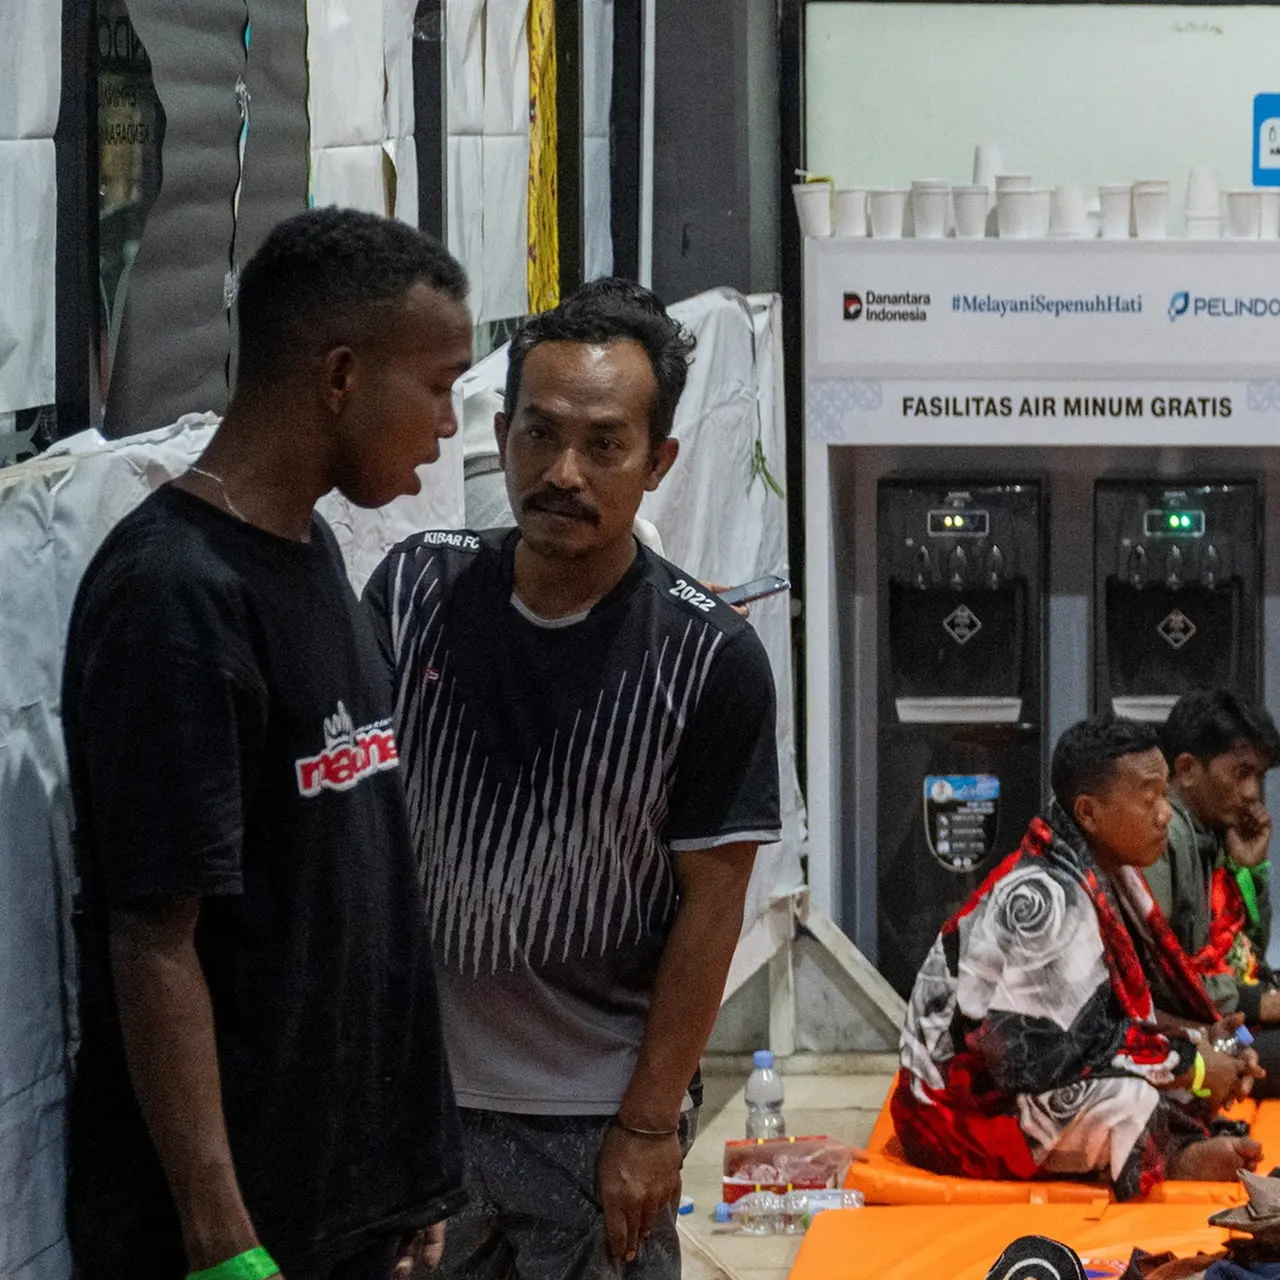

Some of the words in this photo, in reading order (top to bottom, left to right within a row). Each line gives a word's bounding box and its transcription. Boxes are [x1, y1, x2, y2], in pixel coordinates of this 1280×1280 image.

[866, 291, 931, 306] Danantara
[952, 294, 1143, 317] #MelayaniSepenuhHati
[866, 307, 927, 322] Indonesia
[902, 396, 1013, 417] FASILITAS
[1019, 397, 1057, 417] AIR
[1064, 397, 1144, 418] MINUM
[1151, 397, 1233, 418] GRATIS
[423, 531, 463, 547] KIBAR
[462, 535, 480, 549] FC
[668, 578, 717, 613] 2022
